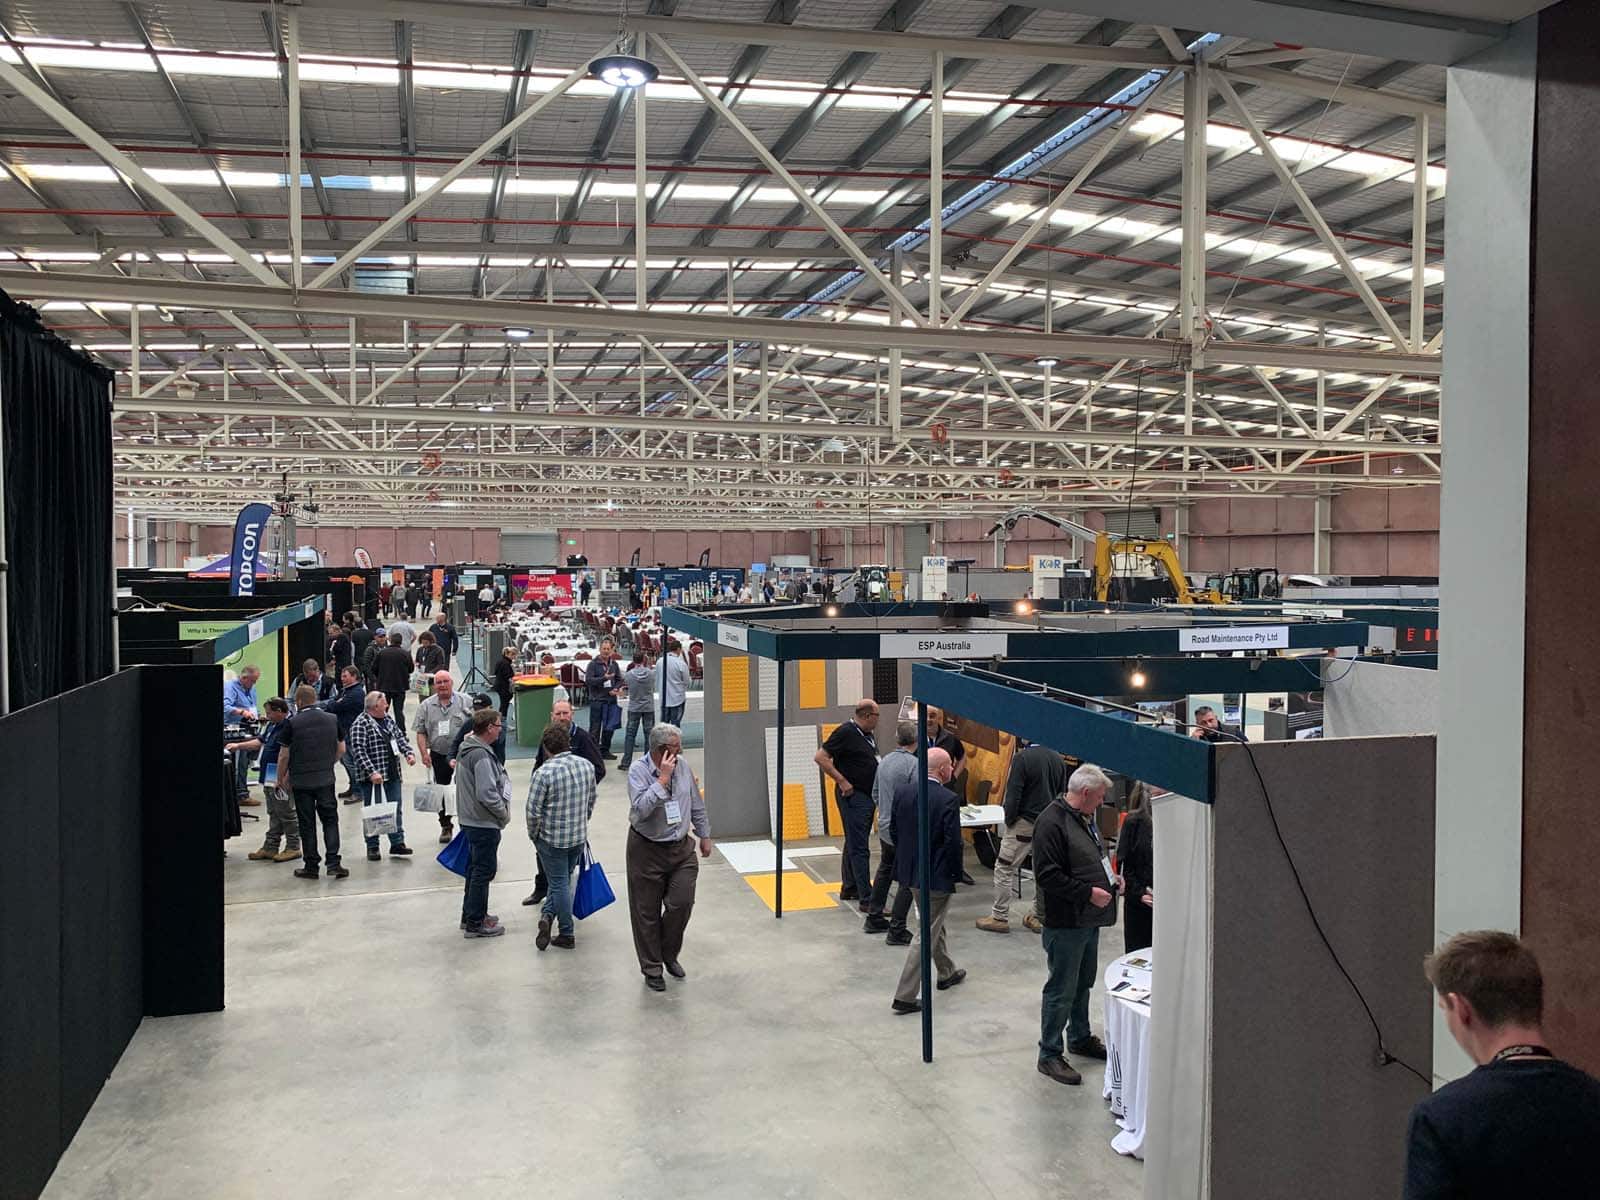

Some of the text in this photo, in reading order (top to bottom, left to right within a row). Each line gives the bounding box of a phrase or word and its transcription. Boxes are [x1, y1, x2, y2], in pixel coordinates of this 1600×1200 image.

[1191, 631, 1278, 644] Road Maintenance Pty Ltd
[918, 640, 971, 650] ESP Australia
